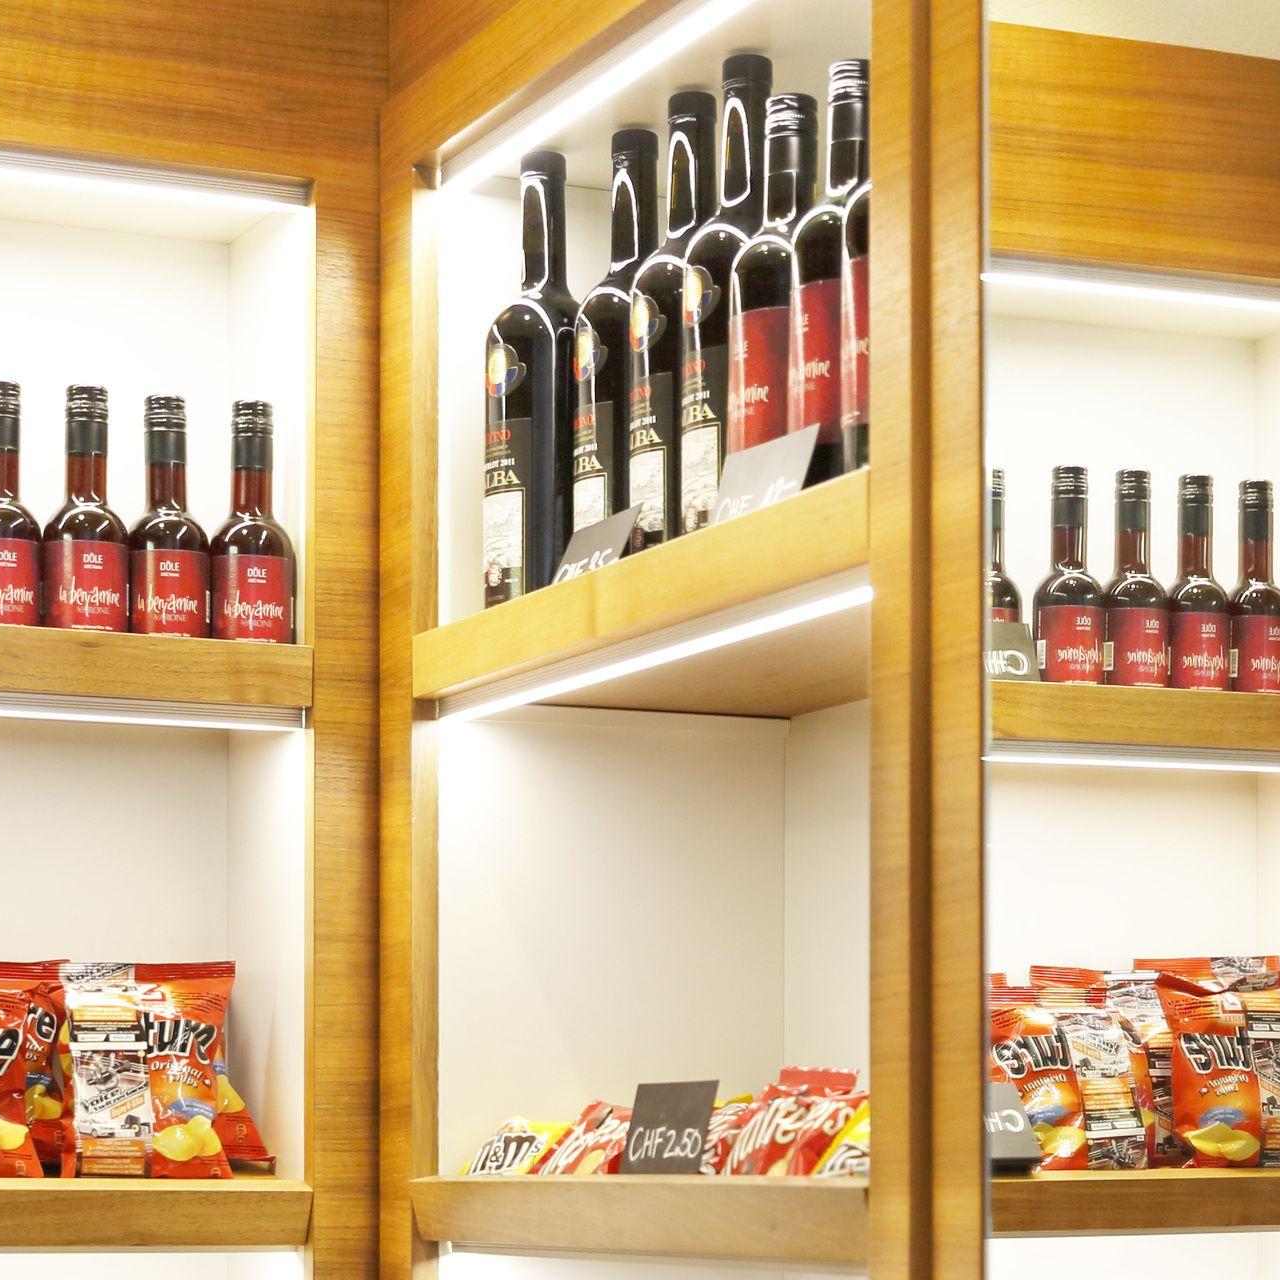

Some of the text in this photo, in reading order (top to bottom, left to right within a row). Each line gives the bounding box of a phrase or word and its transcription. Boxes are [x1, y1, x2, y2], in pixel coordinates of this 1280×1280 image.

[84, 552, 102, 564] DÔLE
[160, 560, 180, 572] DÔLE
[248, 566, 266, 578] DÔLE
[629, 1126, 702, 1161] CHF 2.50
